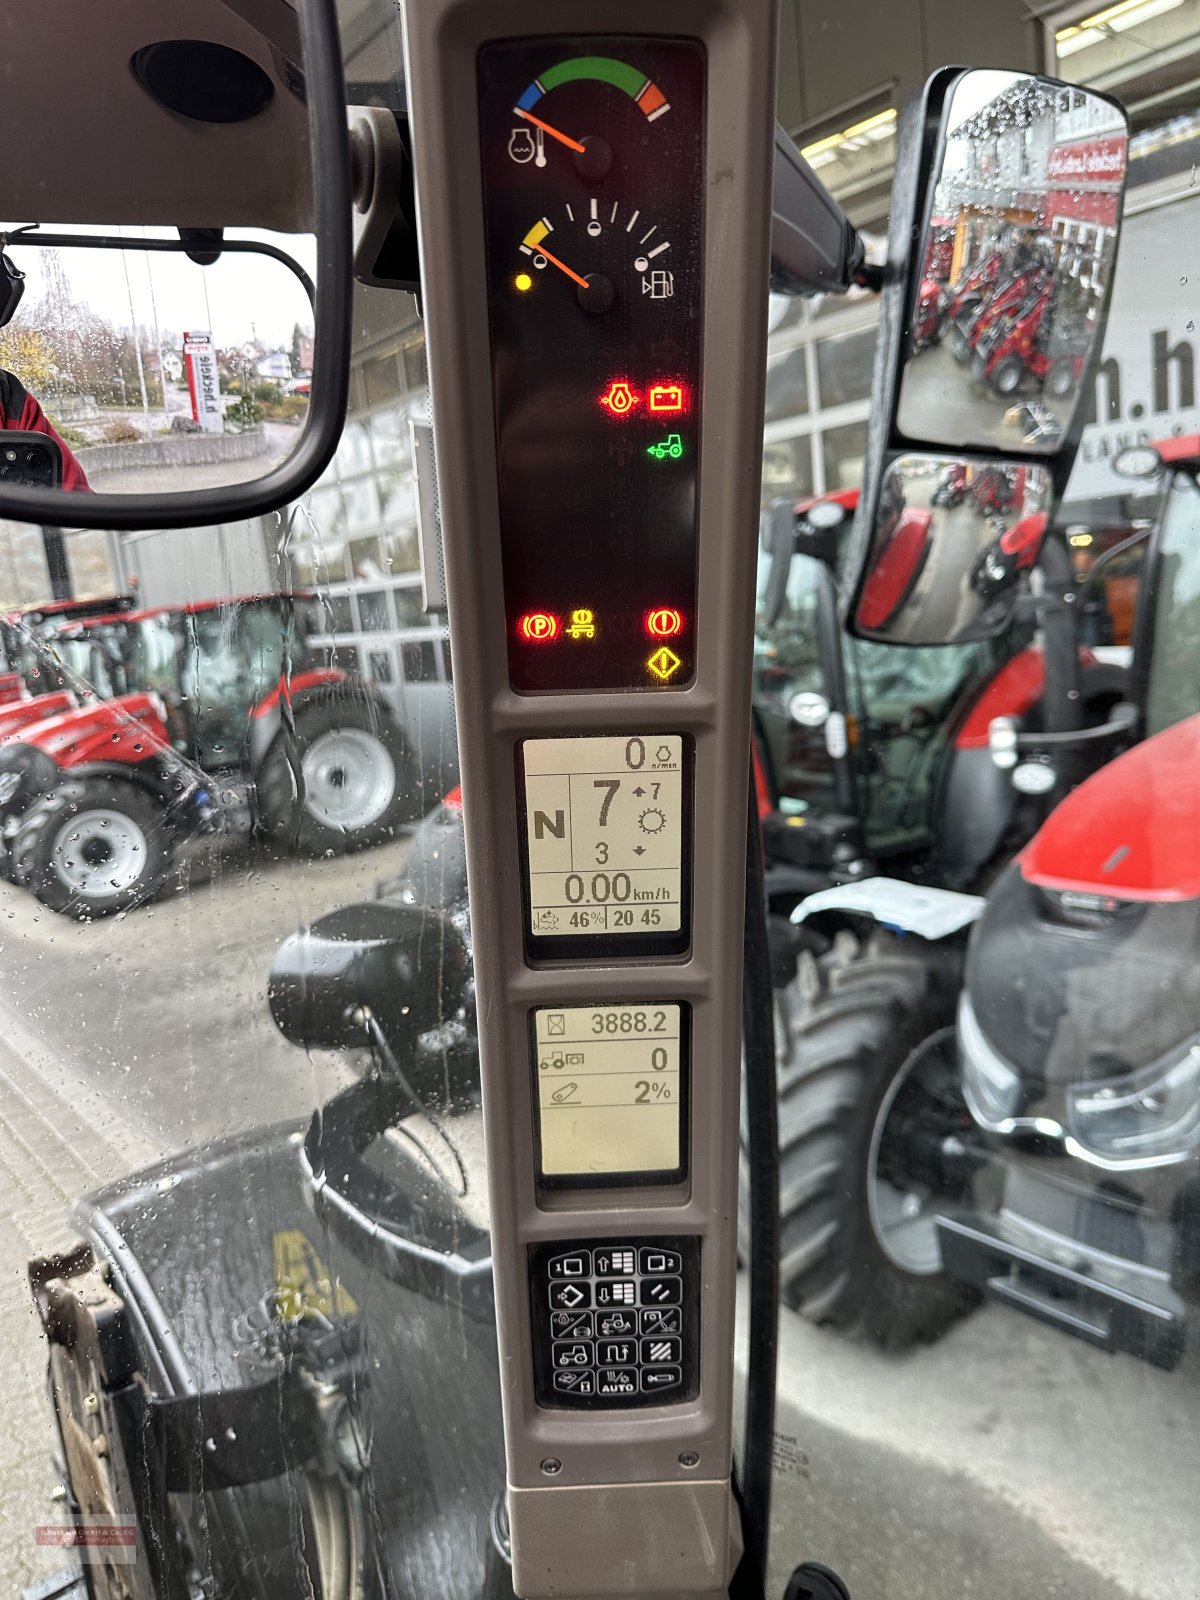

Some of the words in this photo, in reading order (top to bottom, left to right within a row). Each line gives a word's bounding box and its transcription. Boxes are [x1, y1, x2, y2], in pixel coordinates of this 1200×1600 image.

[625, 737, 646, 770] 0
[650, 782, 661, 800] 7
[593, 780, 621, 827] 7
[534, 810, 565, 839] N
[594, 842, 609, 865] 3
[564, 873, 631, 904] 0.00
[633, 887, 670, 901] km/h
[614, 910, 634, 927] 20
[640, 909, 661, 926] 45
[591, 1011, 667, 1034] 3888.2
[651, 1047, 668, 1071] 0
[634, 1080, 671, 1104] 2%
[555, 1263, 562, 1272] 1
[667, 1258, 674, 1267] 2
[602, 1384, 634, 1393] AUTO
